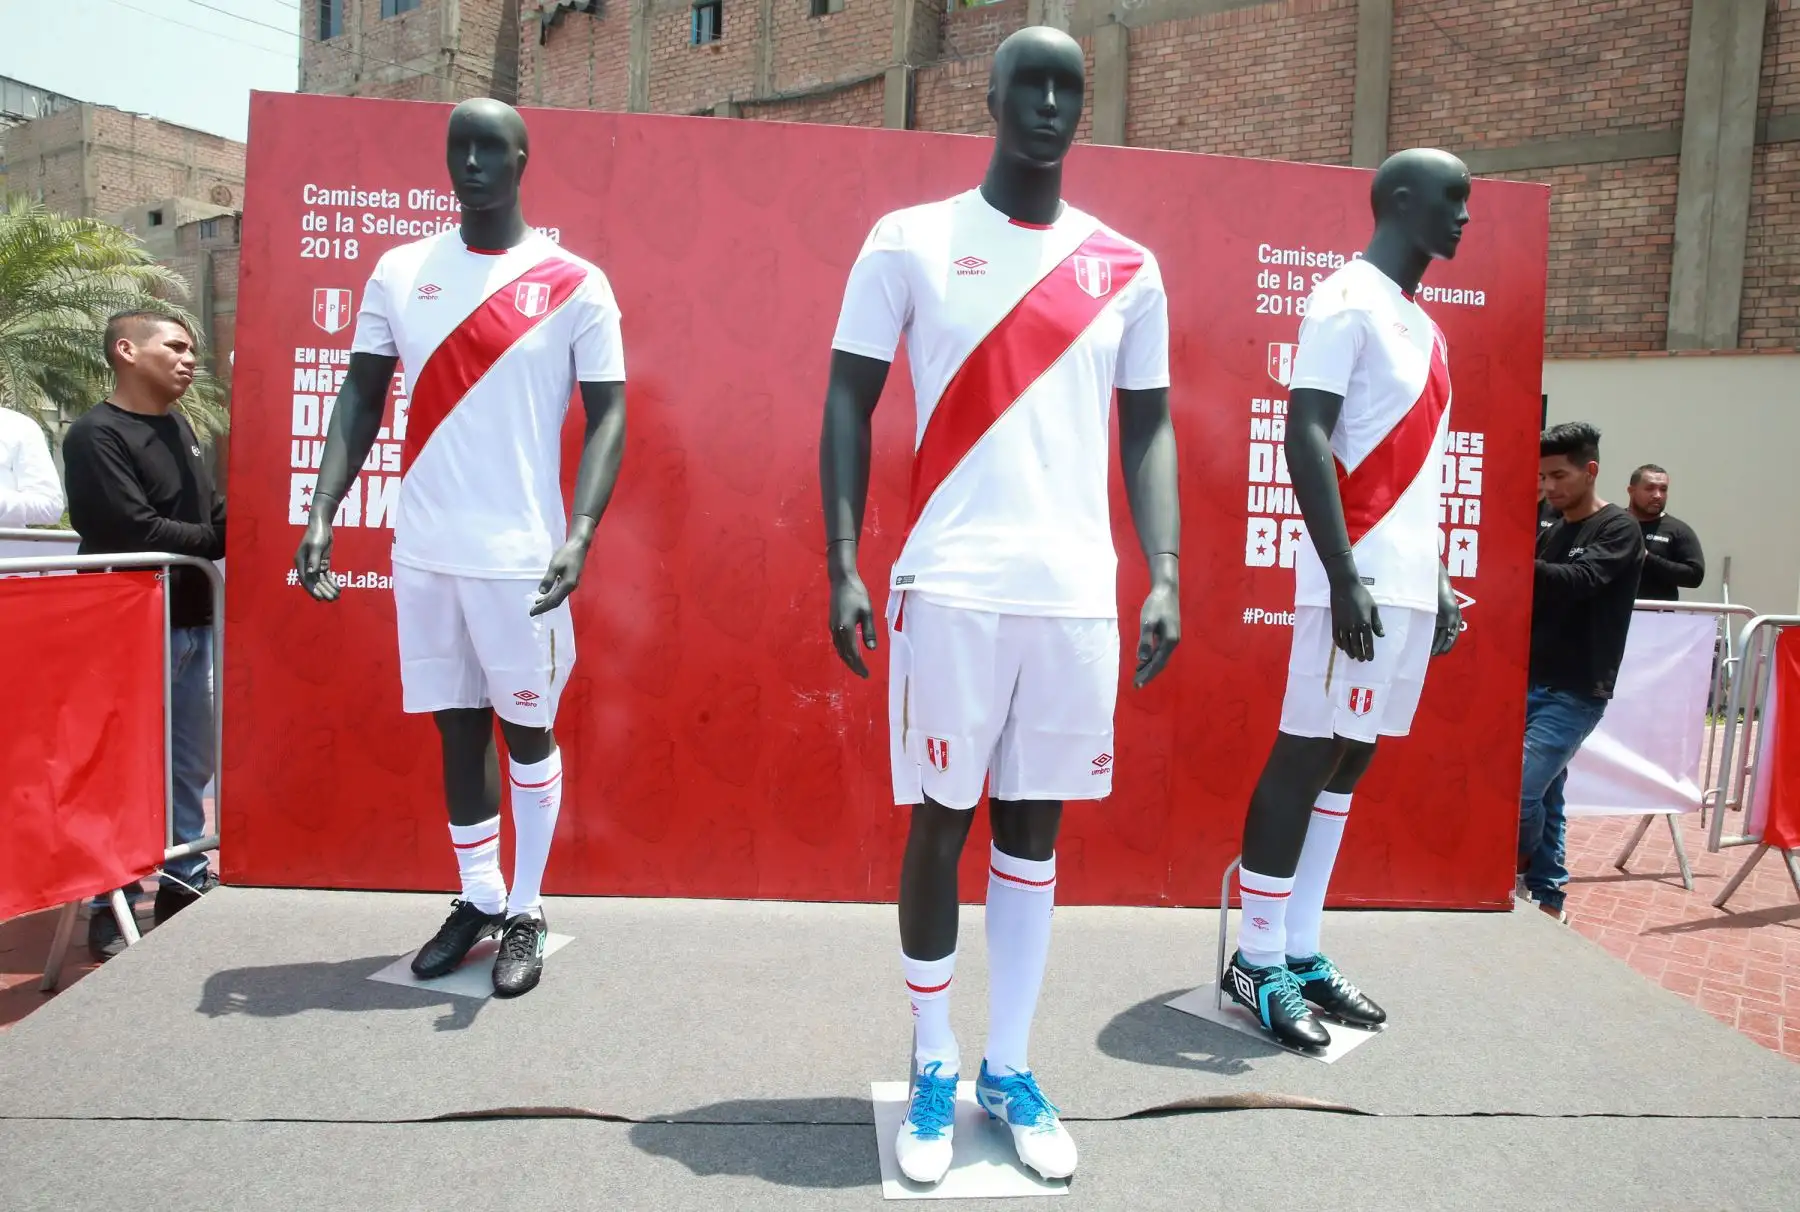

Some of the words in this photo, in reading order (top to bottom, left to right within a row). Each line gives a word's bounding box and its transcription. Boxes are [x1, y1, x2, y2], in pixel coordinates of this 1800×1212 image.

[303, 183, 400, 209] Camiseta
[407, 188, 462, 212] Ofici
[302, 210, 328, 232] de
[335, 211, 354, 233] la
[300, 236, 359, 260] 2018
[1258, 243, 1345, 269] Camiseta
[1257, 268, 1280, 289] de
[1287, 270, 1304, 291] la
[1256, 293, 1308, 317] 2018
[294, 347, 316, 363] EN
[318, 348, 351, 365] RUS
[1251, 398, 1271, 414] EN
[1250, 414, 1286, 442] MÁ
[515, 700, 538, 708] umbro
